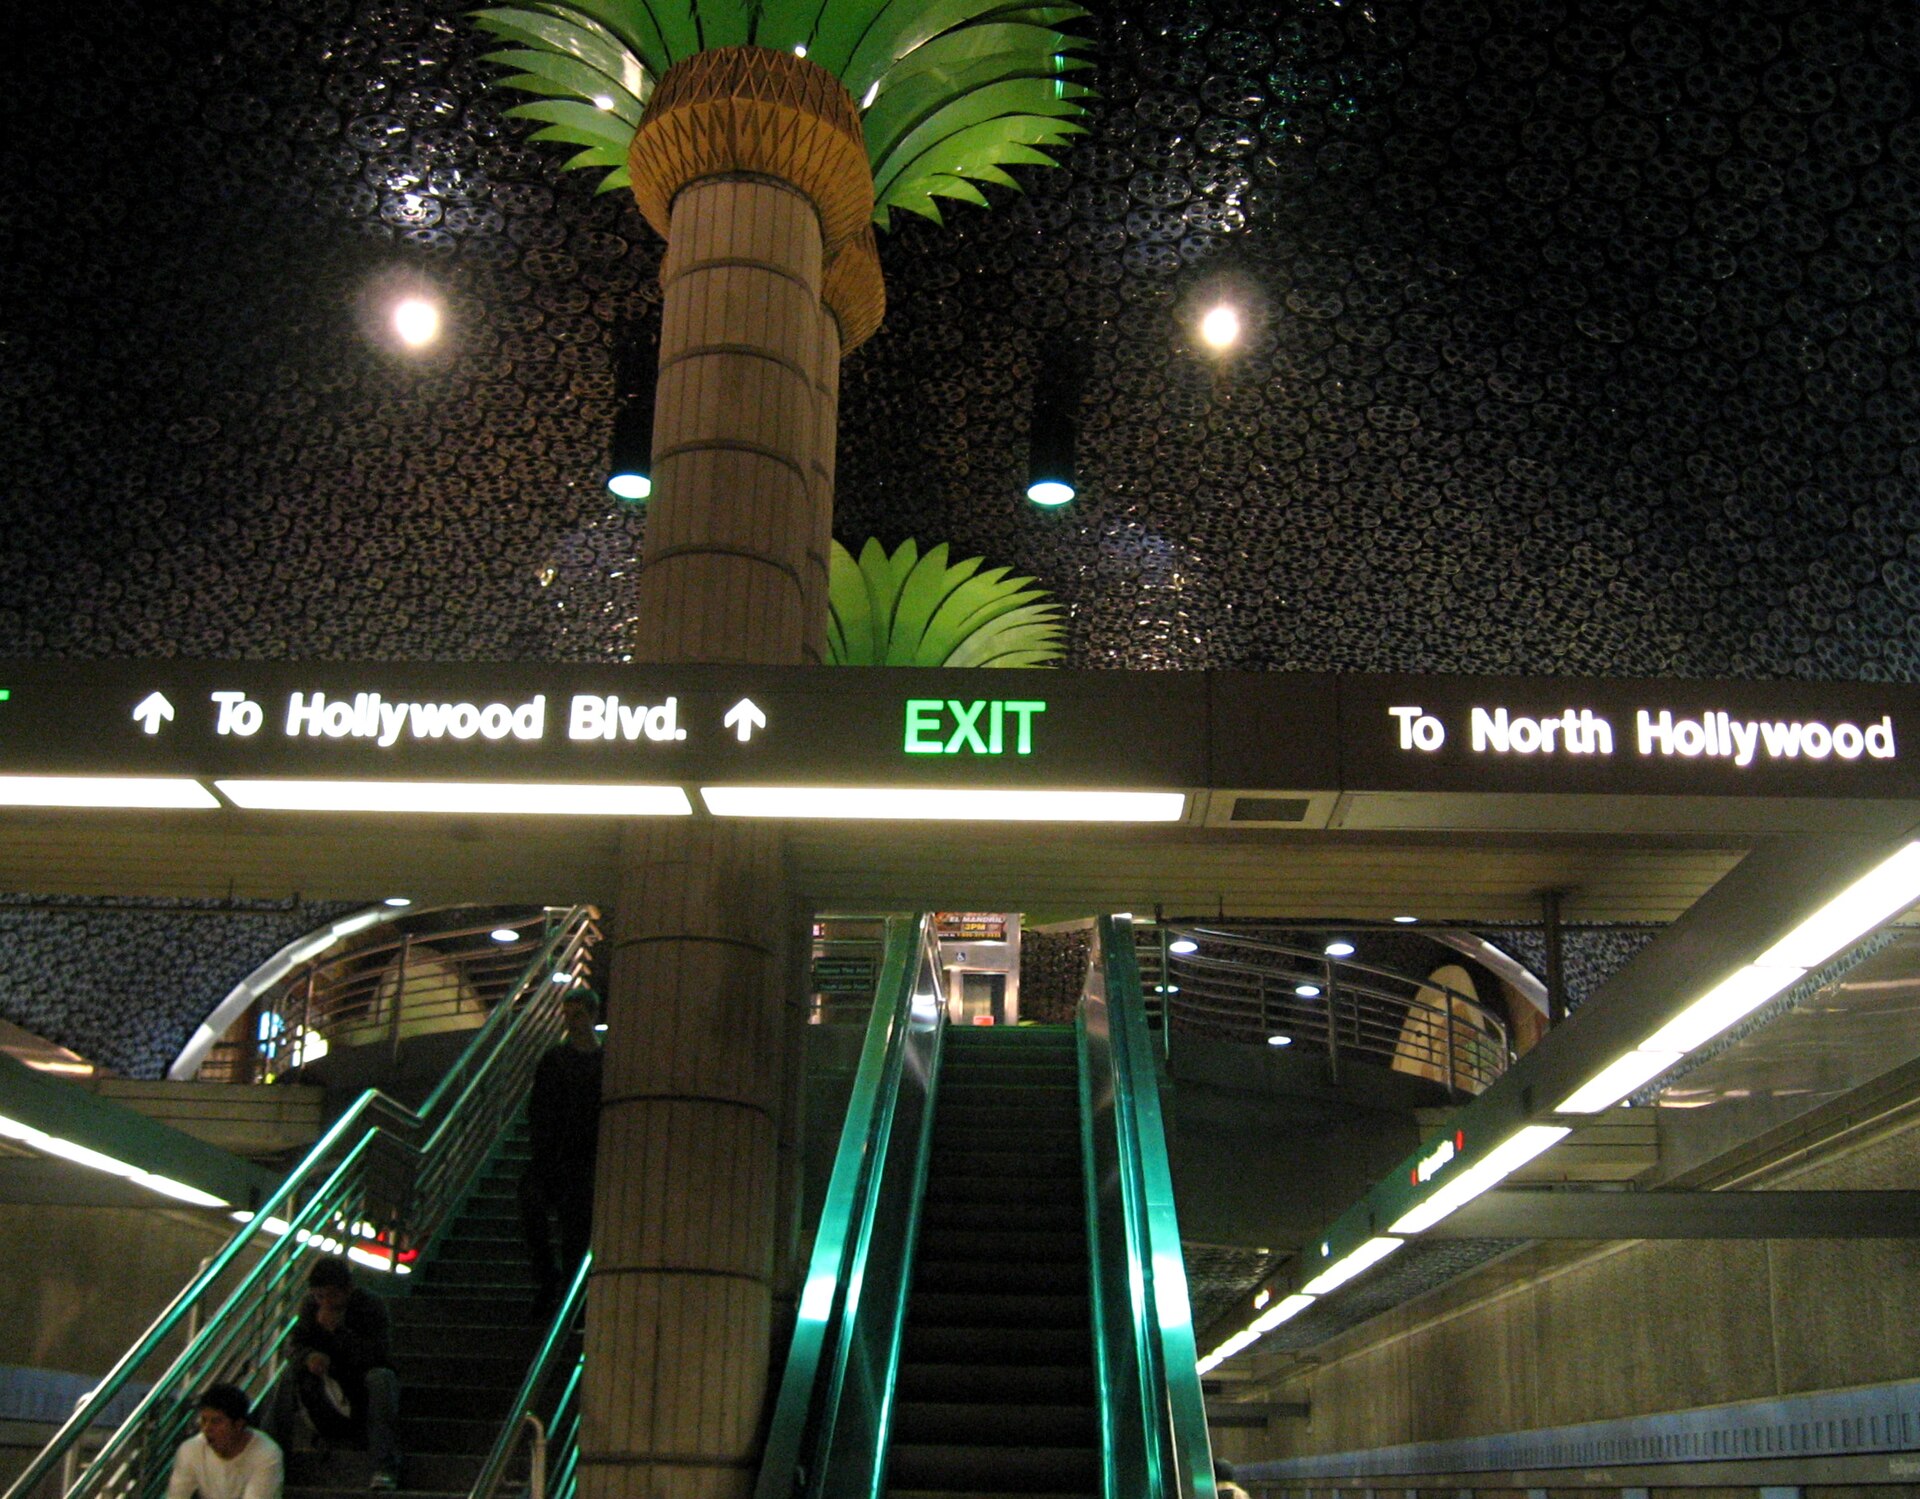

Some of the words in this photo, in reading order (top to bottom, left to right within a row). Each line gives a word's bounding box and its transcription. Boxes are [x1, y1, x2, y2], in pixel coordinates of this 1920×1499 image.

[210, 691, 263, 737] To
[285, 691, 547, 748] Hollywood
[568, 694, 688, 743] Blvd.
[904, 699, 1047, 755] EXIT
[1388, 706, 1445, 752] To
[1470, 707, 1614, 756] North
[1636, 709, 1896, 767] Hollywood
